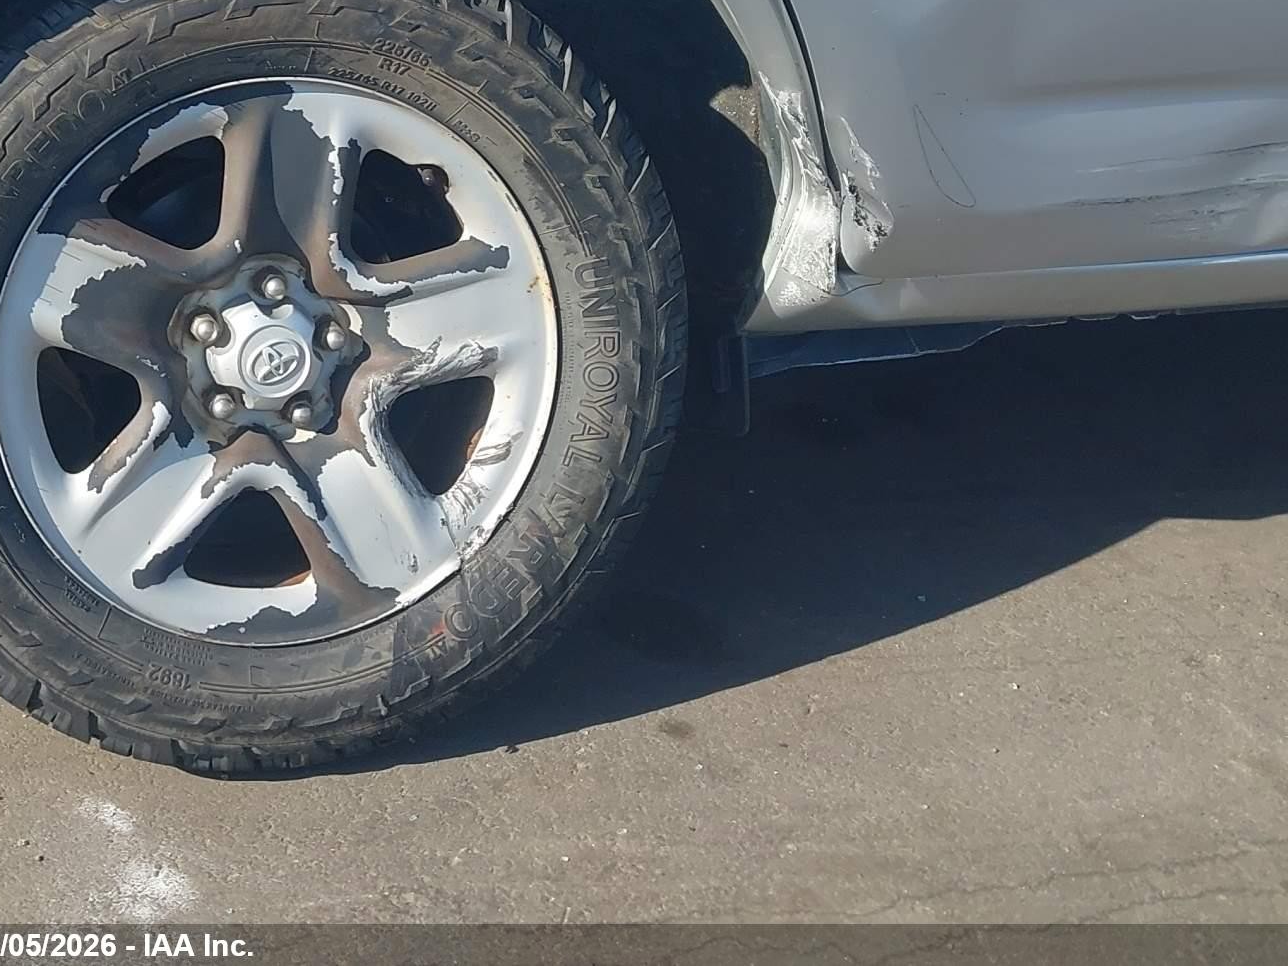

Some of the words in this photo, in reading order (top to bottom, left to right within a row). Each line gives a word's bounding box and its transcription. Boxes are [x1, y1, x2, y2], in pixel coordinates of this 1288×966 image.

[373, 37, 432, 68] 225/65
[378, 57, 412, 77] R17
[327, 66, 379, 86] 225/65
[380, 80, 406, 96] R17
[562, 256, 622, 468] UNIROYAL
[443, 482, 586, 641] LAREDO
